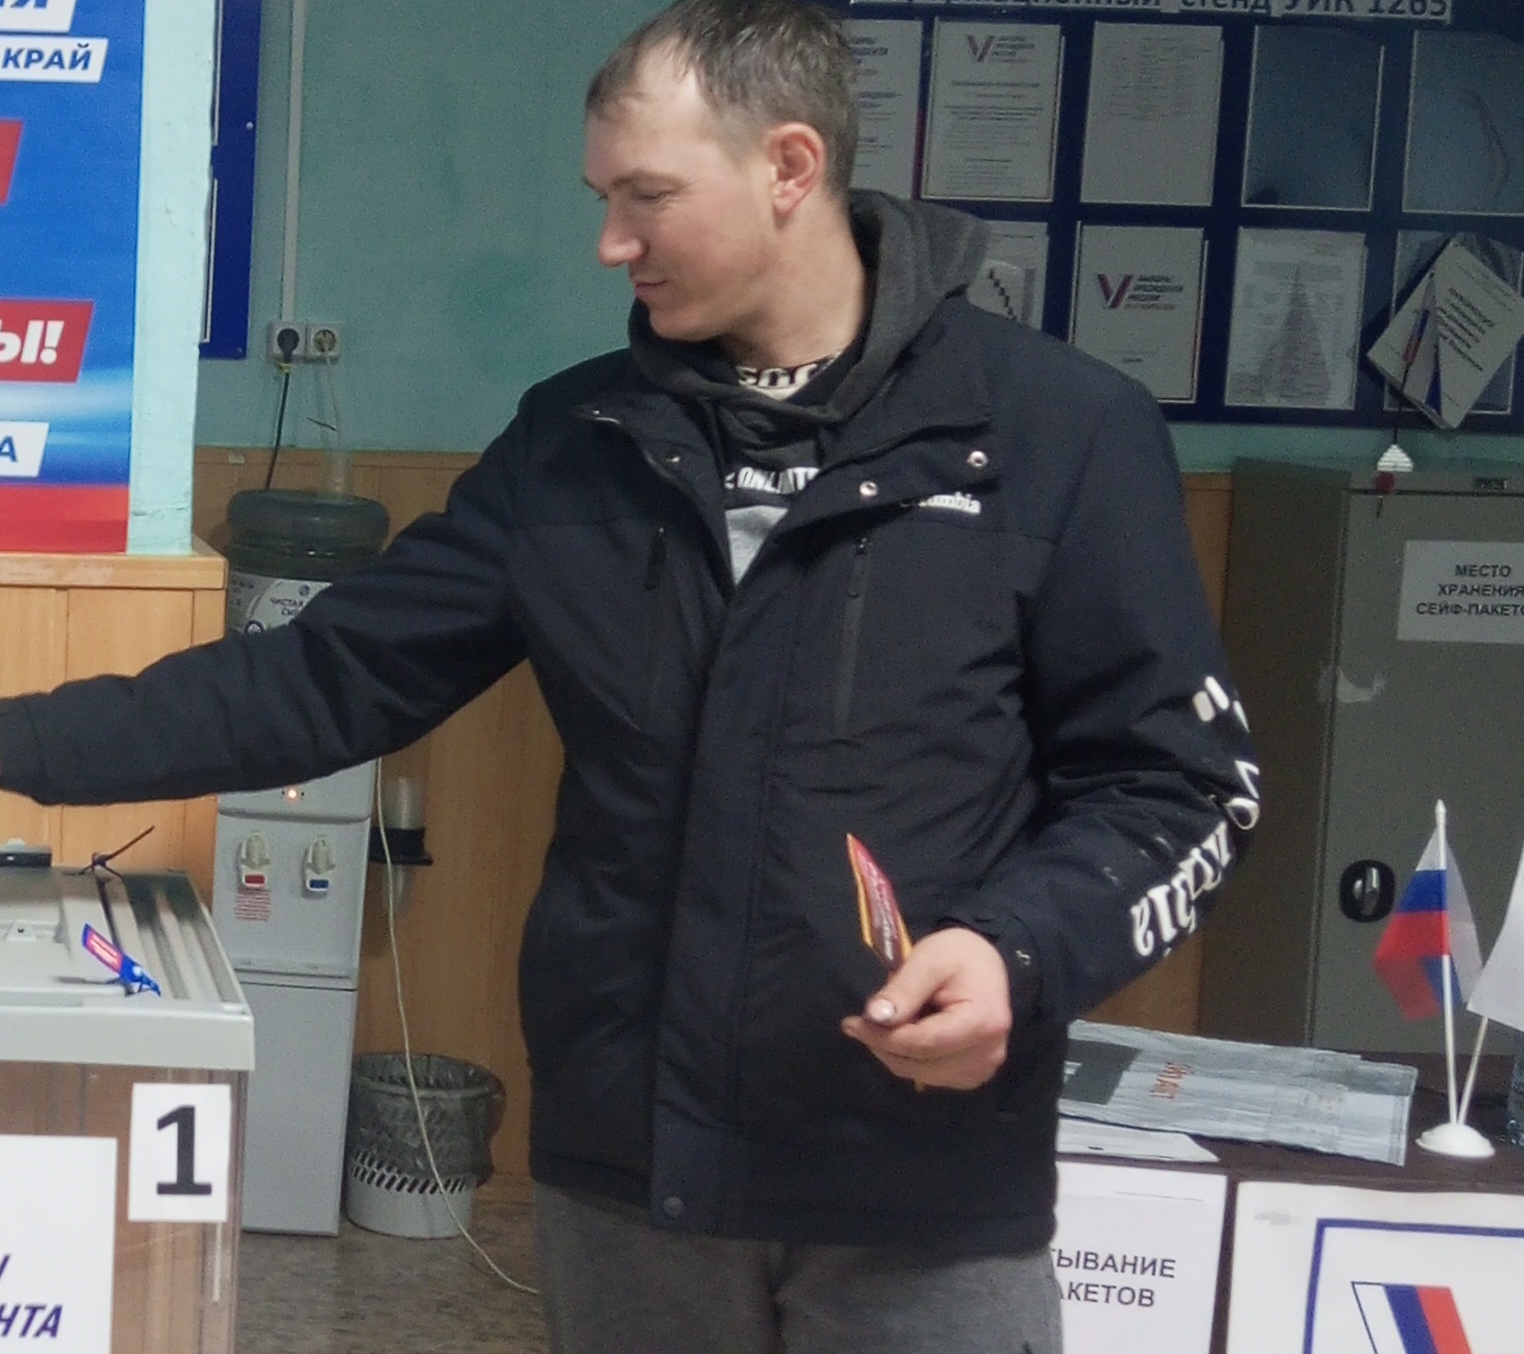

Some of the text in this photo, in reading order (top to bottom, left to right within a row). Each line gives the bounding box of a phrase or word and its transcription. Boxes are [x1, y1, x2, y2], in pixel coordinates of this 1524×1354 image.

[1, 42, 93, 71] КРАЙ
[1454, 564, 1512, 578] МЕСТО
[1437, 583, 1524, 597] ХРАНЕНИЯ
[154, 1104, 214, 1197] 1
[1051, 1248, 1177, 1279] ЫВАНИЕ
[1060, 1281, 1156, 1308] КЕТОВ
